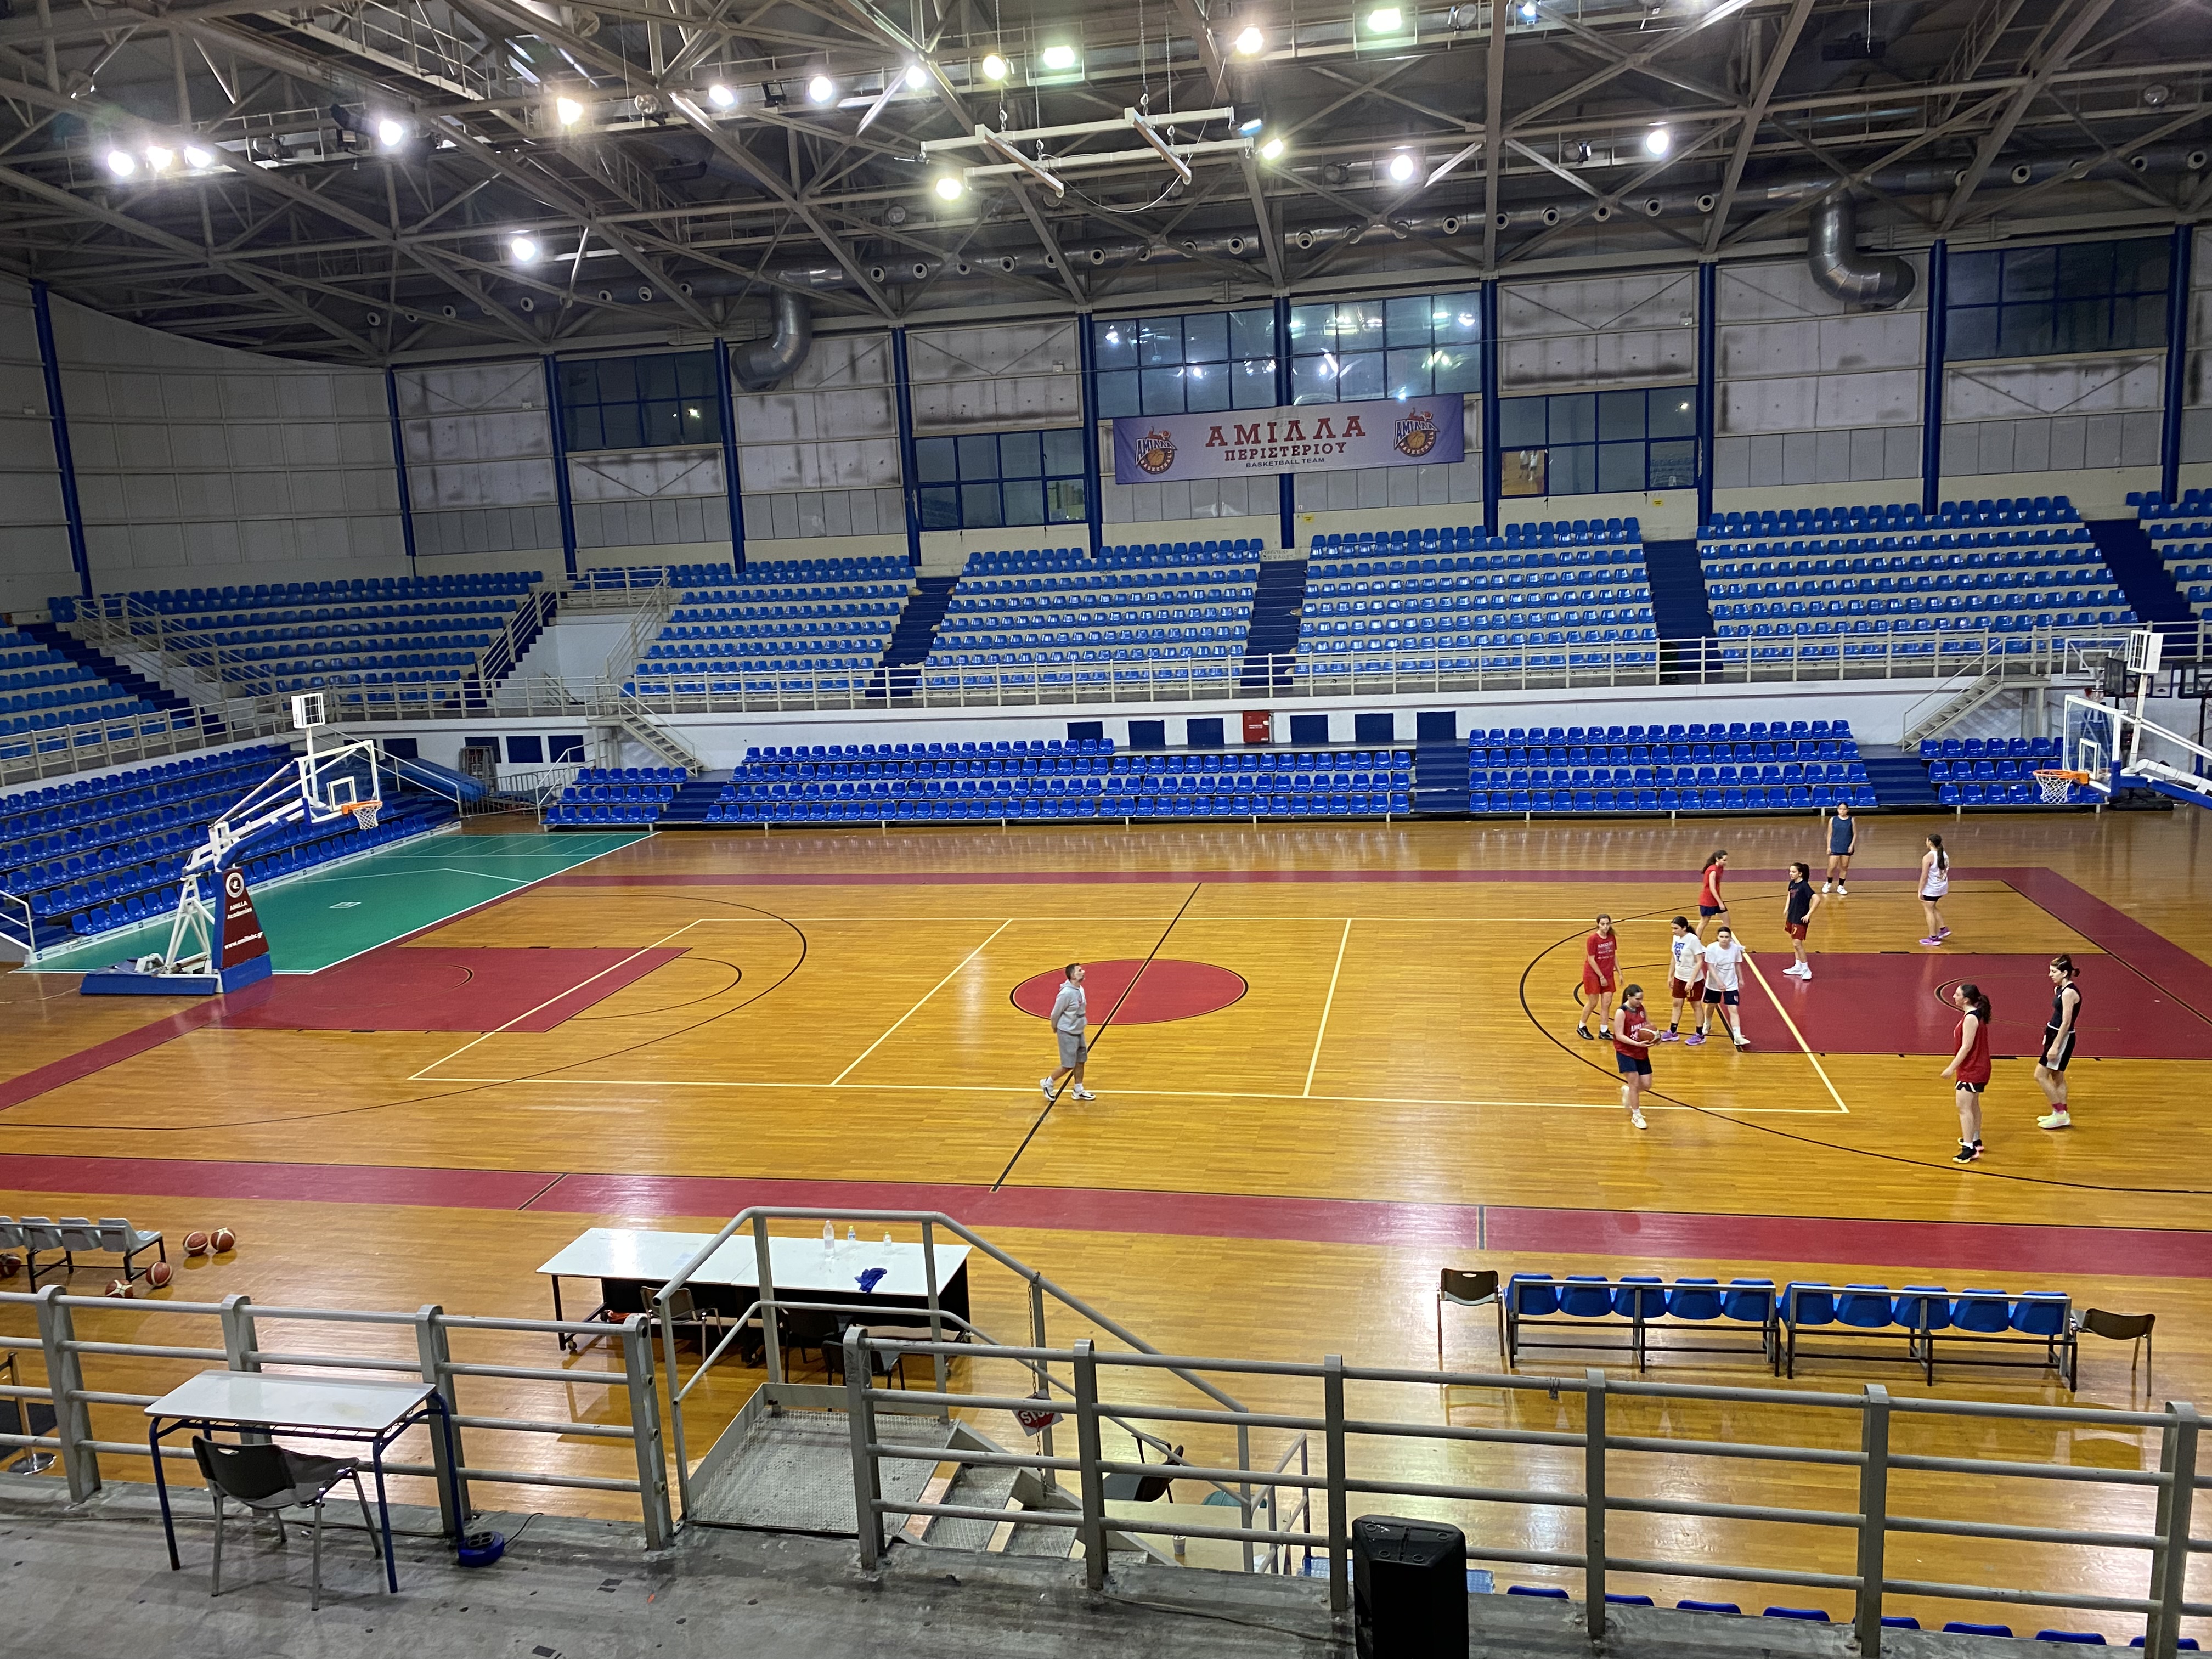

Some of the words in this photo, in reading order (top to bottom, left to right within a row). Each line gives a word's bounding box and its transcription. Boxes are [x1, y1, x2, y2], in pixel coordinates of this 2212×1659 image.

[1205, 415, 1366, 448] ΑΜΙΛΛΑ
[1224, 442, 1347, 461] ΠΕΡΙΣΤΕΡΙΟΥ
[1246, 459, 1300, 467] BASKETBALL
[229, 900, 248, 911] AMILLA
